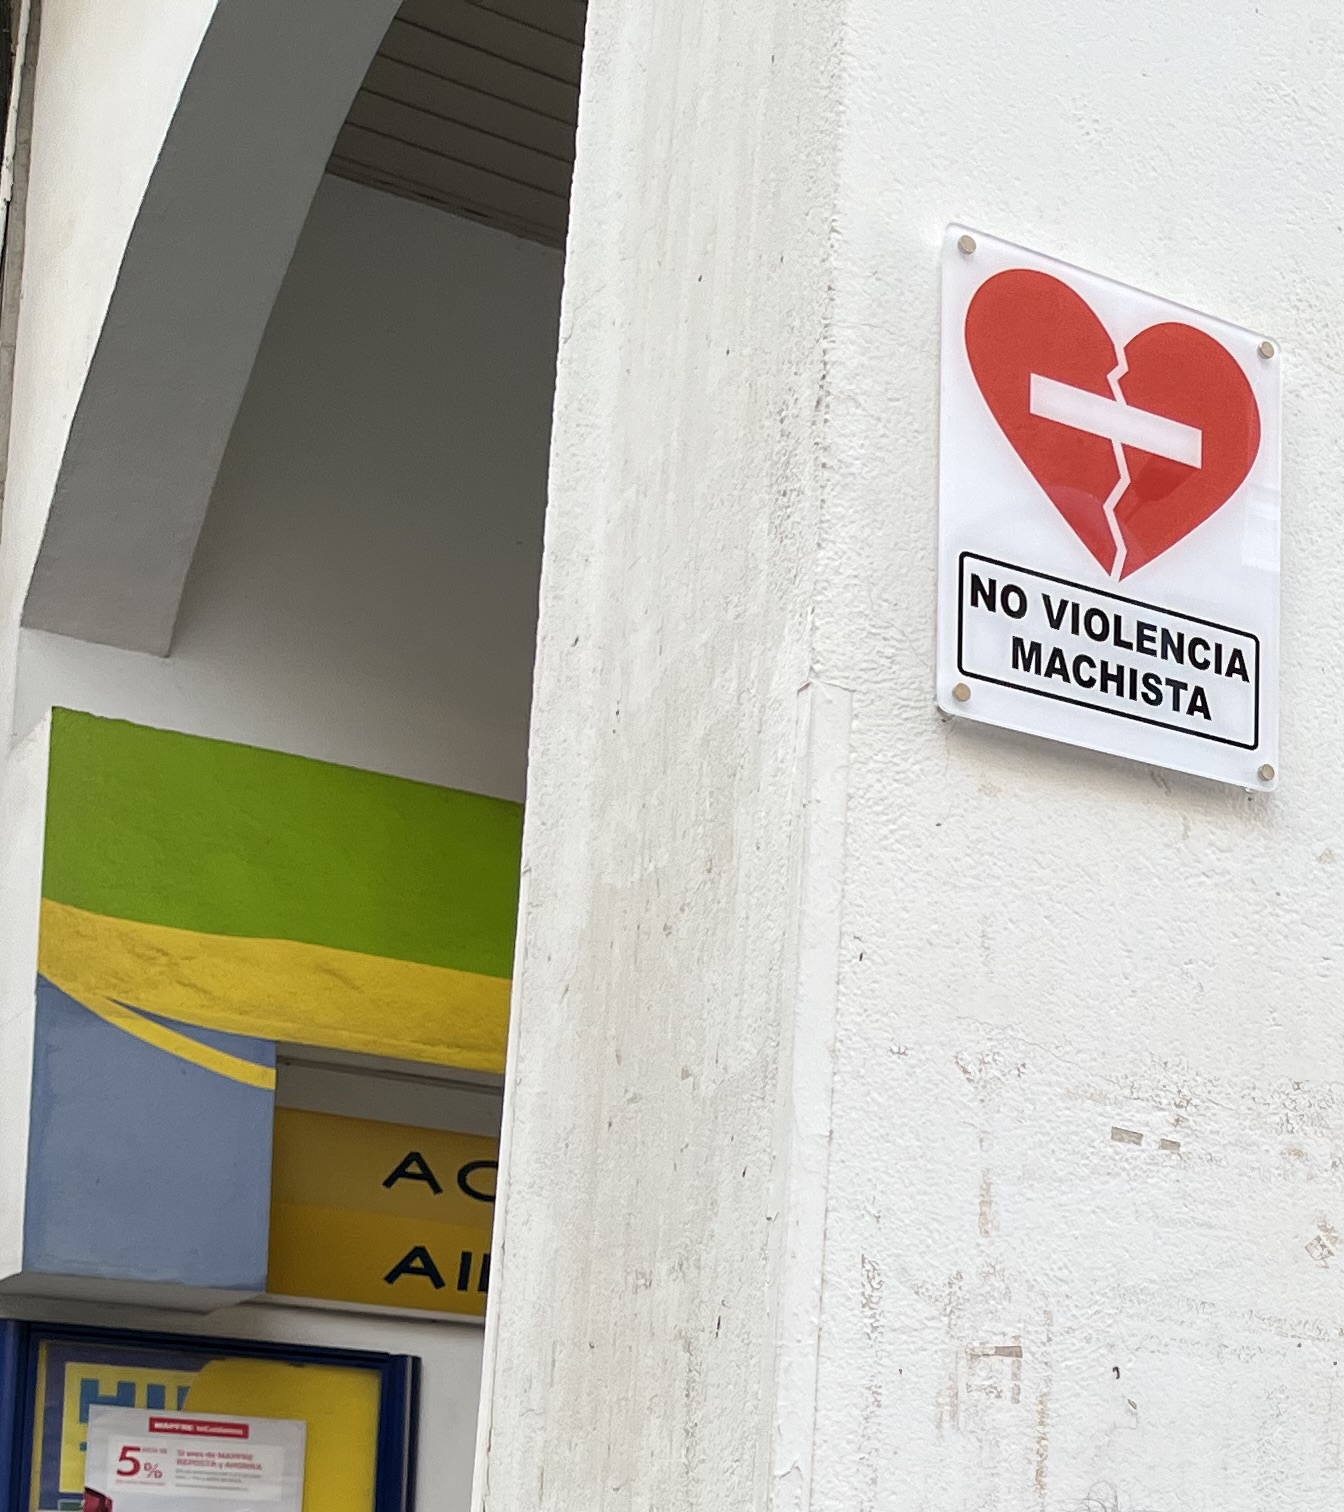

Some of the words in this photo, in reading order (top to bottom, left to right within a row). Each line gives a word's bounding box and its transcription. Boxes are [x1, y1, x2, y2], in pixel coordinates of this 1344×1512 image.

[969, 573, 1028, 619] NO
[1041, 593, 1250, 683] VIOLENCIA
[1011, 636, 1212, 721] MACHISTA
